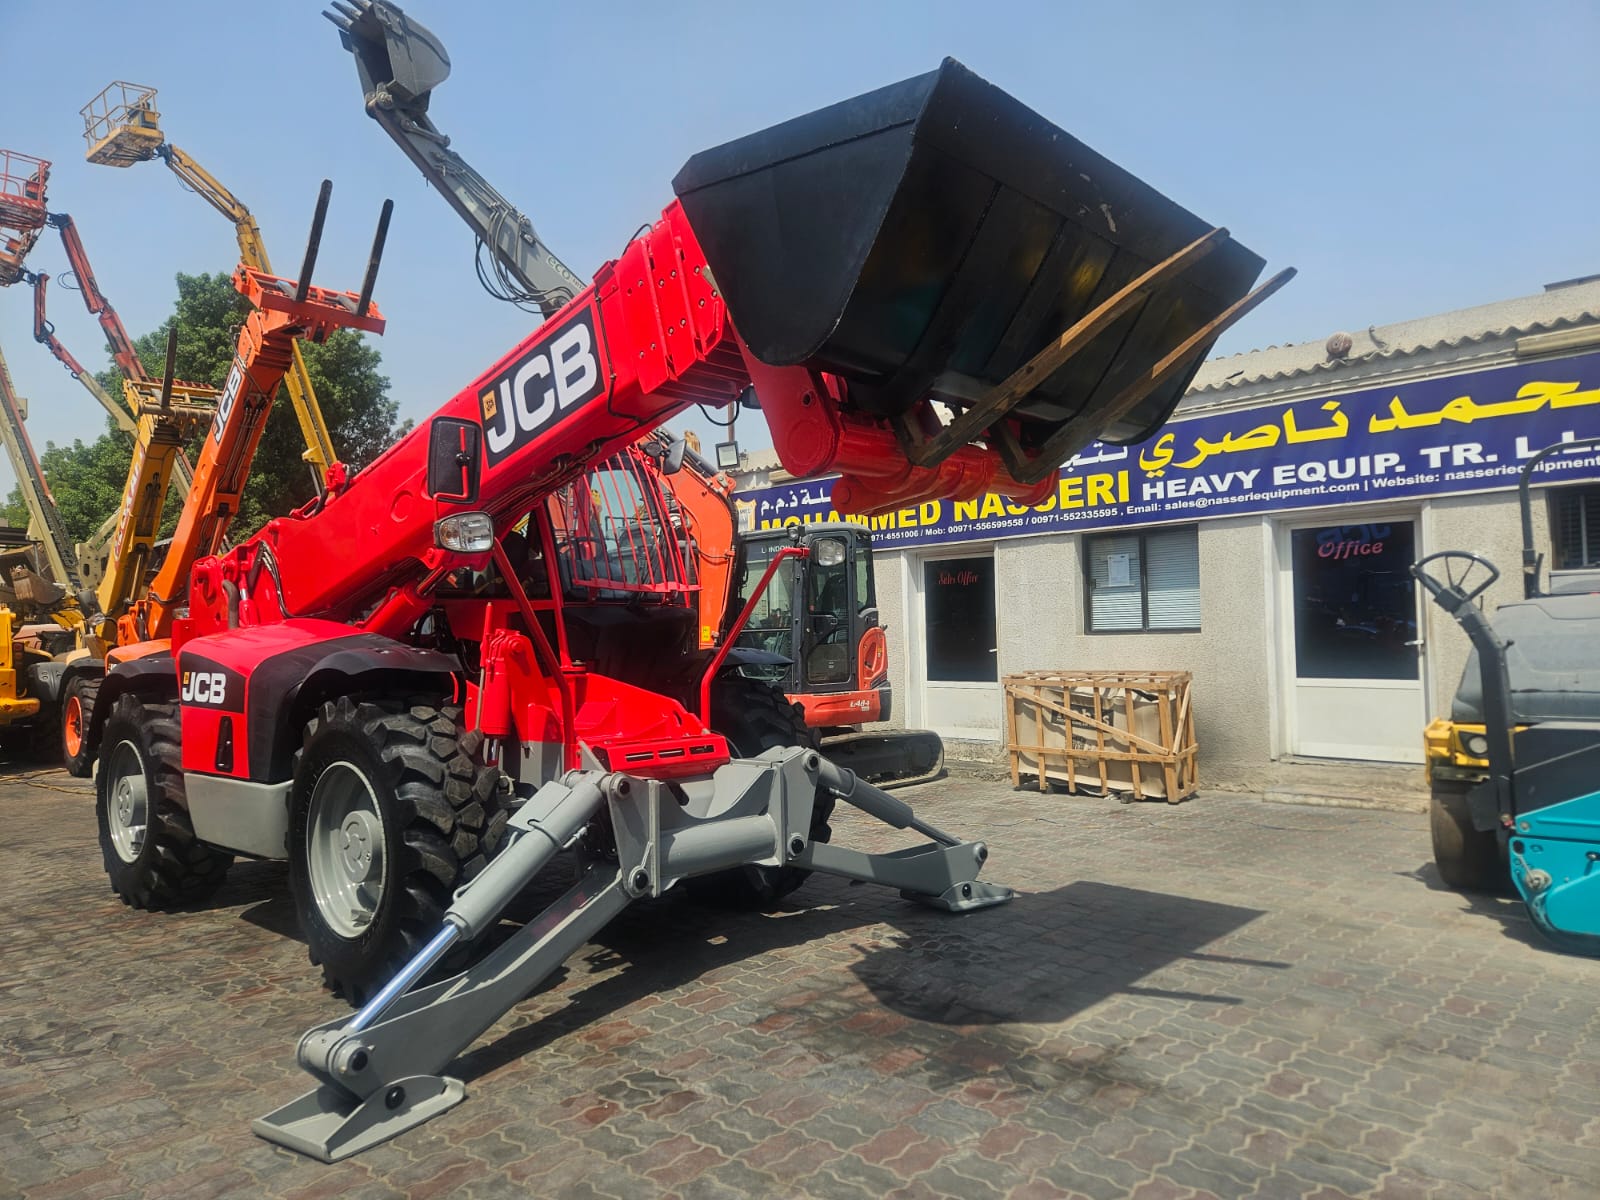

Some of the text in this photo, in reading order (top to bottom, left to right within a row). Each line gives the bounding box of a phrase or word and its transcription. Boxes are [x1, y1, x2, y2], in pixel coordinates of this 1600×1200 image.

[215, 365, 242, 443] JCB
[487, 323, 597, 454] JCB
[1138, 400, 1349, 478] ناصري
[1142, 468, 1261, 501] HEAVY
[1273, 453, 1405, 486] EQUIP.
[1420, 442, 1498, 468] TR.
[925, 527, 946, 536] Mob:
[1031, 508, 1117, 524] 00971-552335595
[1126, 503, 1162, 514] Email:
[1165, 482, 1360, 510] sales@nasseriequipment.com
[1372, 473, 1440, 488] Website:
[1317, 541, 1383, 560] Office
[182, 671, 227, 704] JCB
